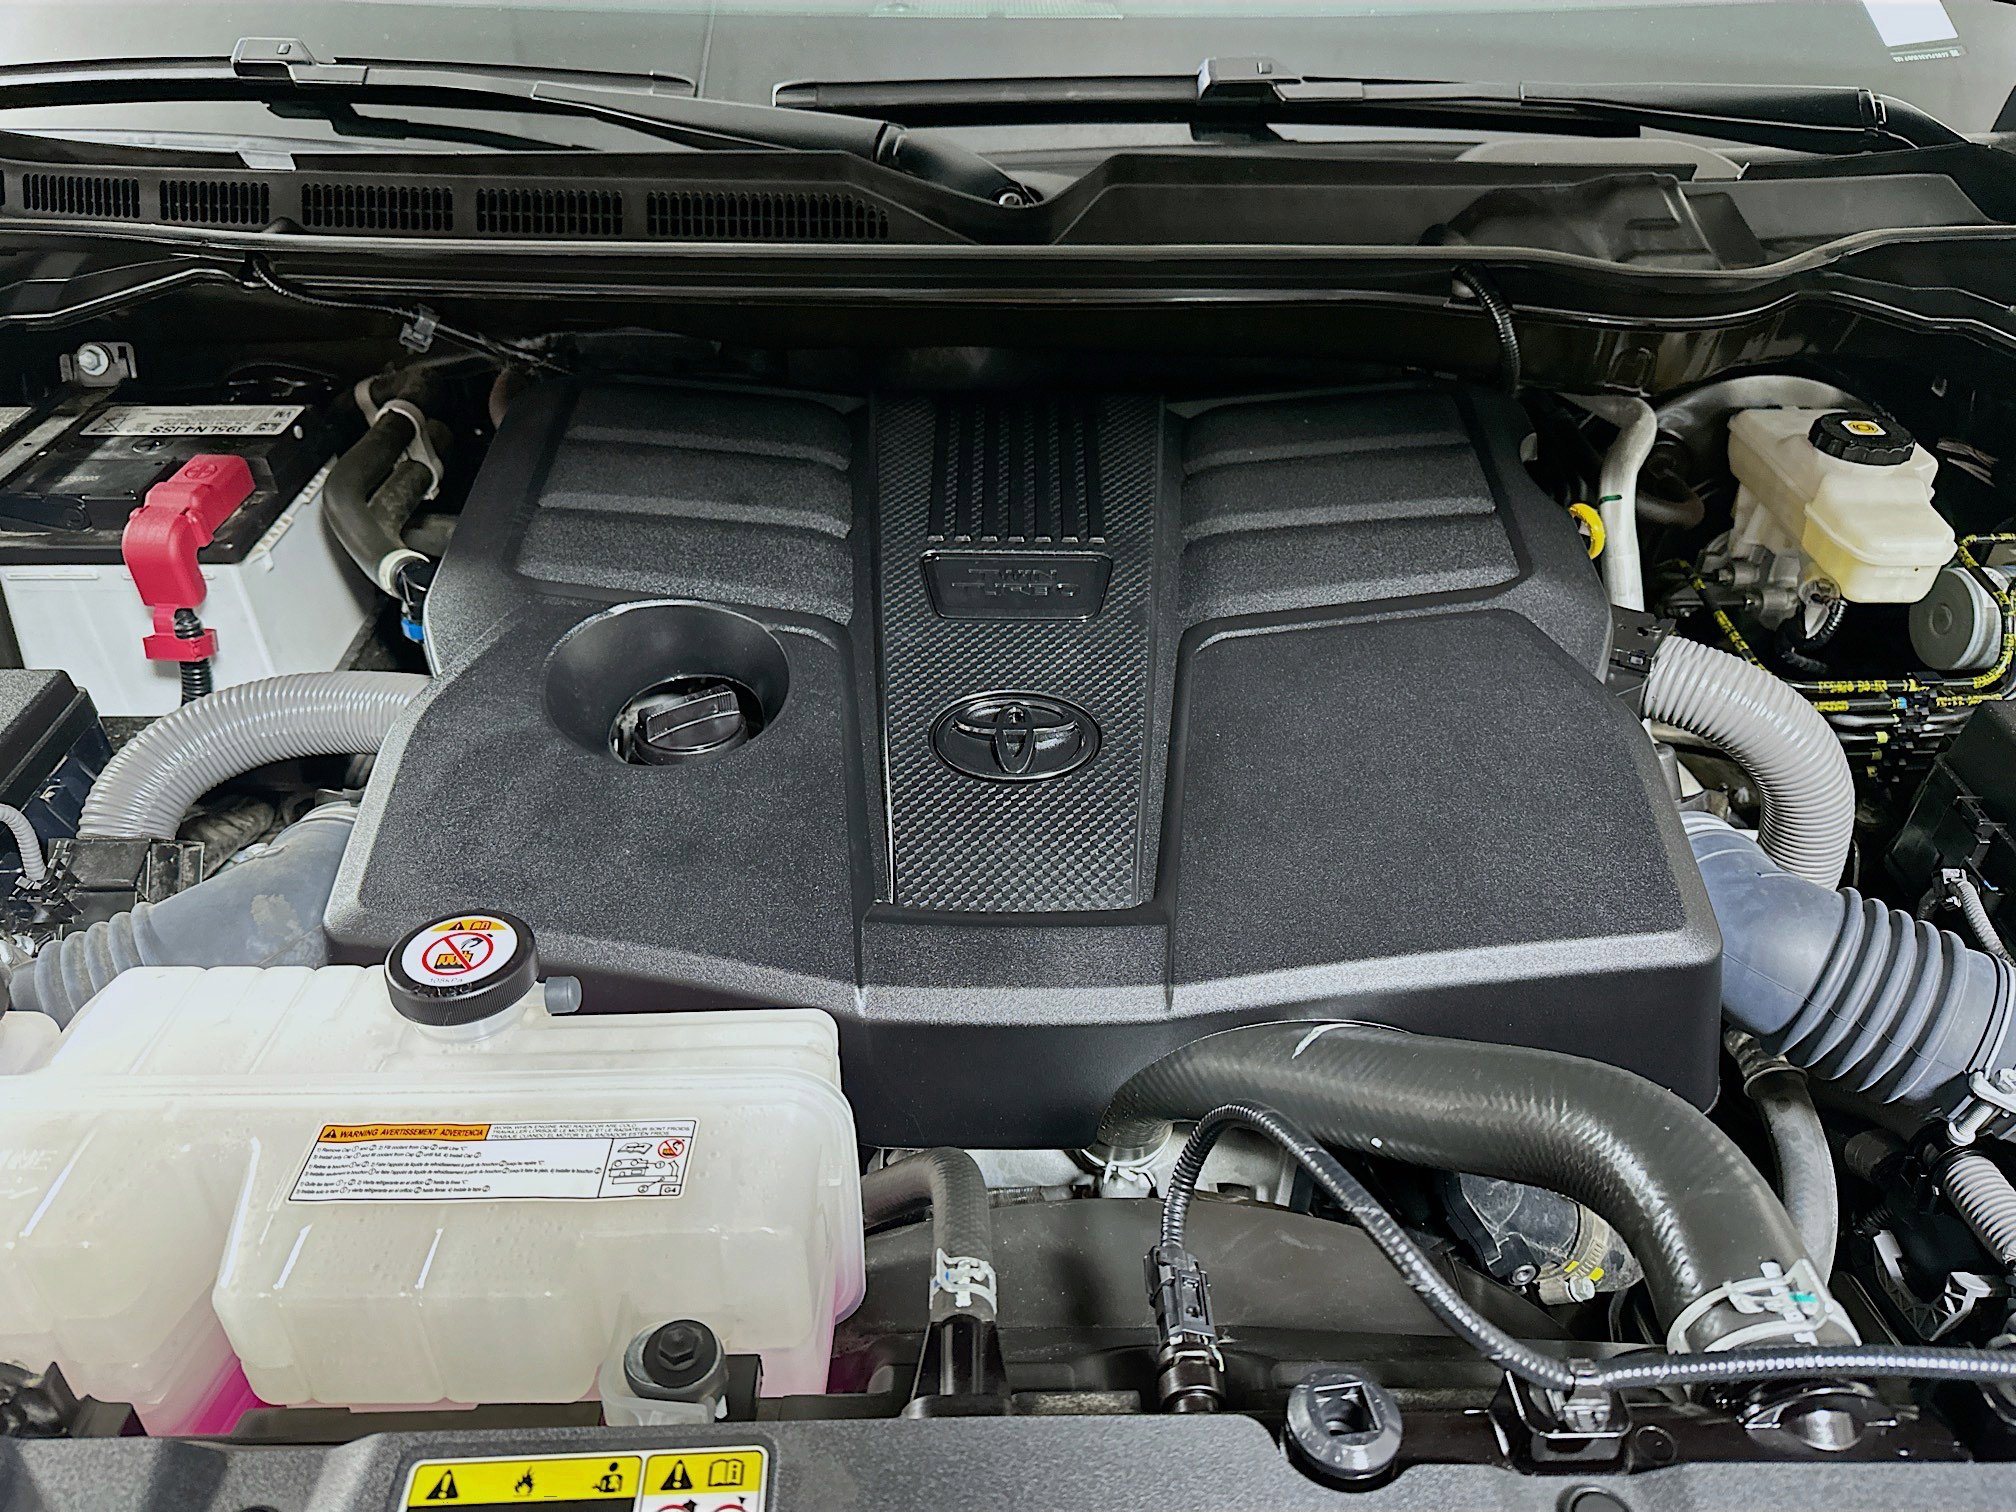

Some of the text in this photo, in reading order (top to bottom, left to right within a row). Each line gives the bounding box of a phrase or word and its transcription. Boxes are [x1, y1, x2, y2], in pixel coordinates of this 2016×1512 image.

[340, 1128, 483, 1138] WARNING AVERTISSEMENT ADVERTENCIA
[664, 1186, 676, 1194] G4
